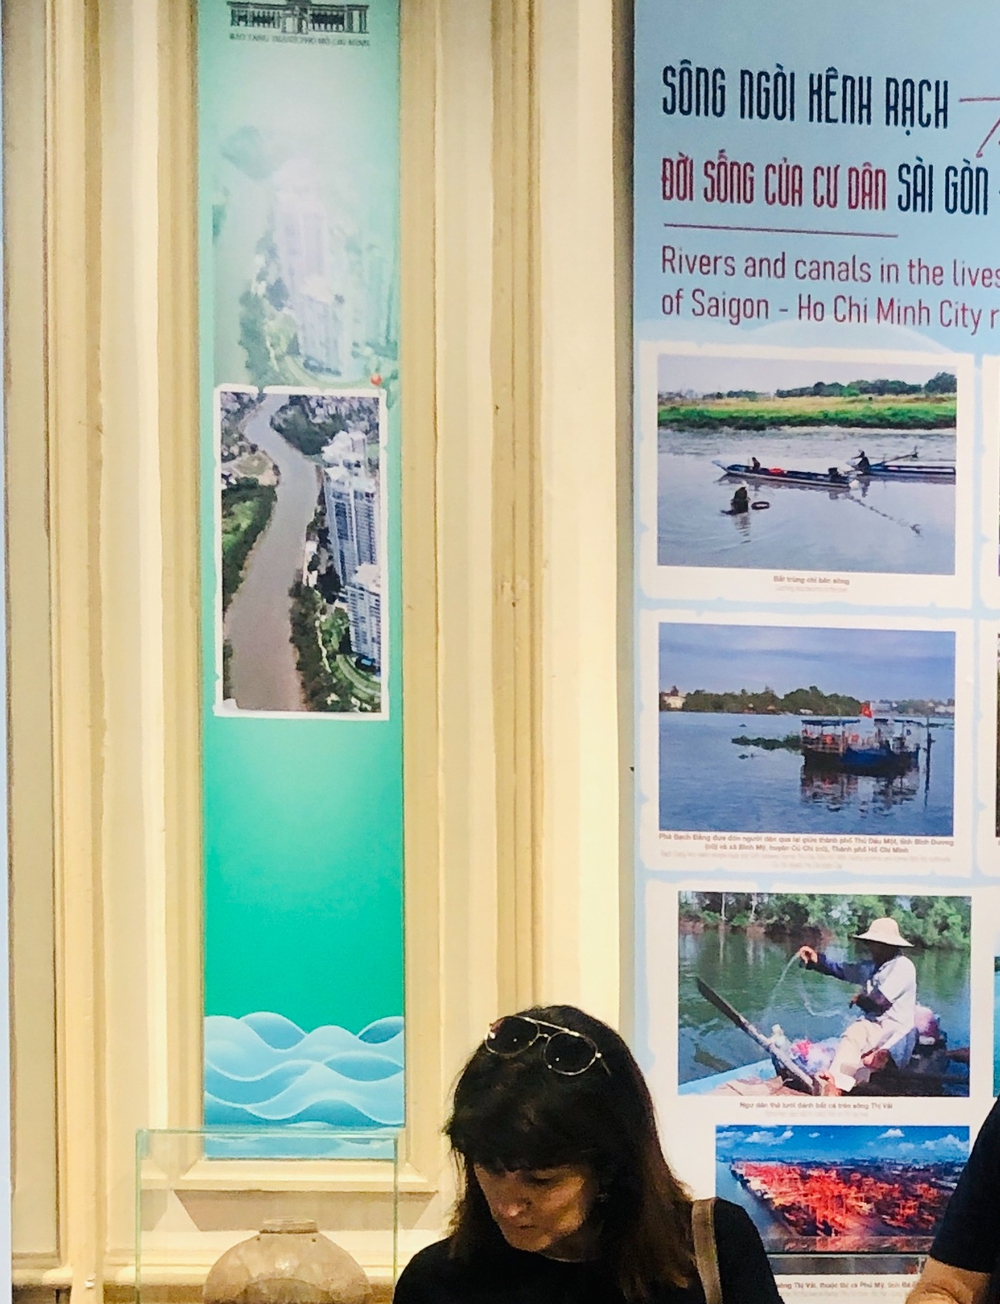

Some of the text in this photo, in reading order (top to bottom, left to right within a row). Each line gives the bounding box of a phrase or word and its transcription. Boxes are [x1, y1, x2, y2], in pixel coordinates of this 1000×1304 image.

[662, 59, 726, 118] SÔNG
[740, 63, 795, 122] NGÒI
[808, 66, 872, 125] KÊNH
[885, 77, 948, 136] RẠCH
[661, 151, 694, 202] ĐỜI
[703, 149, 755, 204] SỐNG
[765, 157, 803, 207] CỦA
[813, 164, 840, 208] CƯ
[848, 161, 887, 211] DÂN
[897, 155, 933, 213] SÀI
[944, 157, 989, 216] GÒN
[661, 245, 736, 277] Rivers
[743, 251, 786, 279] and
[795, 254, 872, 283] canals
[880, 257, 899, 284] in
[907, 257, 944, 286] the
[661, 288, 684, 316] of
[691, 288, 769, 326] Saigon
[798, 293, 825, 322] Ho
[833, 295, 868, 324] Chi
[877, 297, 930, 326] Minh
[939, 299, 983, 336] City
